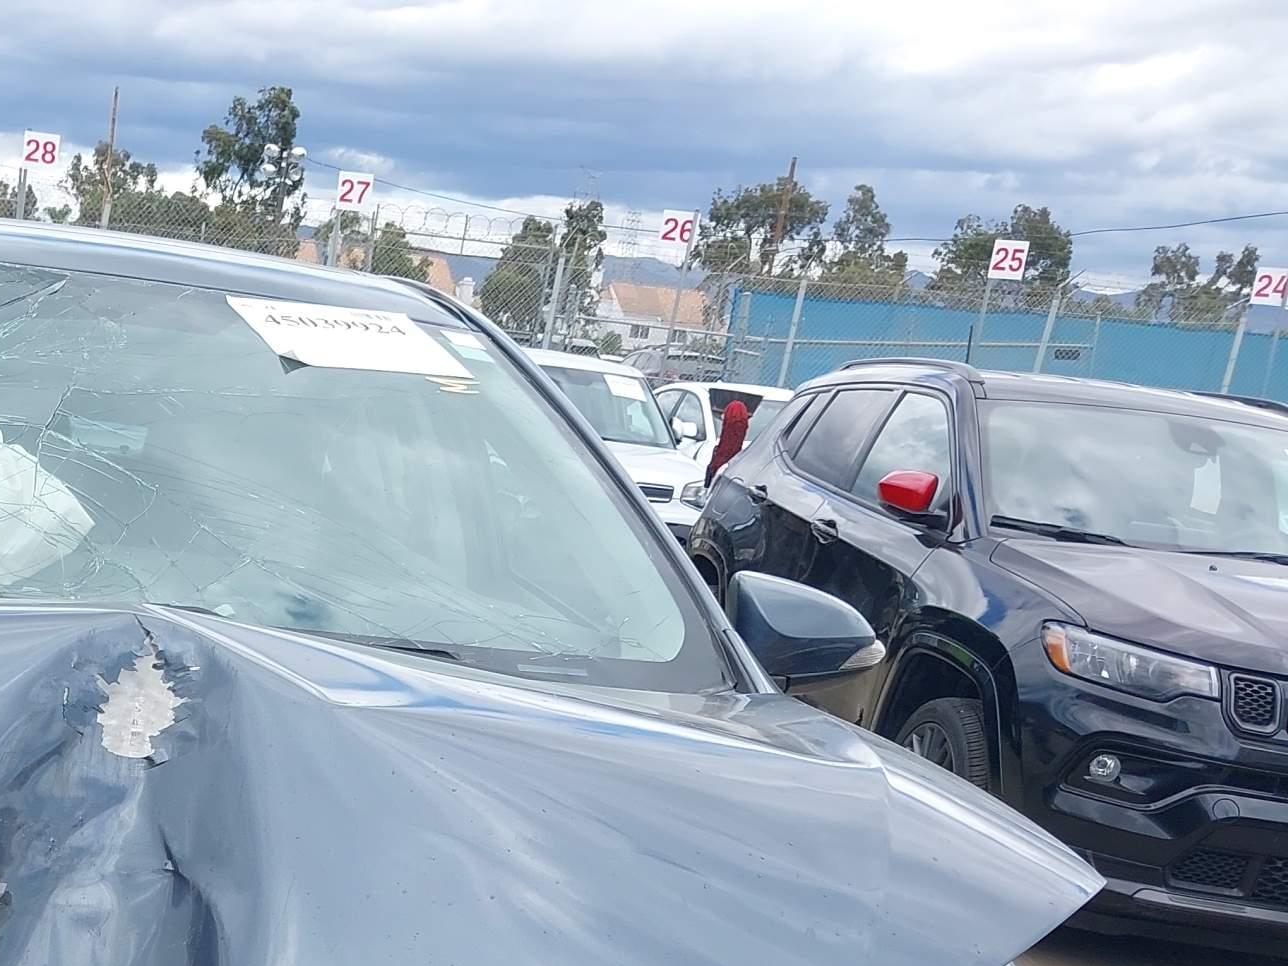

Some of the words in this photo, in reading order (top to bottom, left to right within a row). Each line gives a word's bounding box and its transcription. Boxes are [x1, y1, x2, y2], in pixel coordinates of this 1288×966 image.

[24, 139, 56, 164] 28
[339, 179, 371, 204] 27
[661, 217, 693, 243] 26
[992, 247, 1025, 272] 25
[1254, 274, 1288, 299] 24
